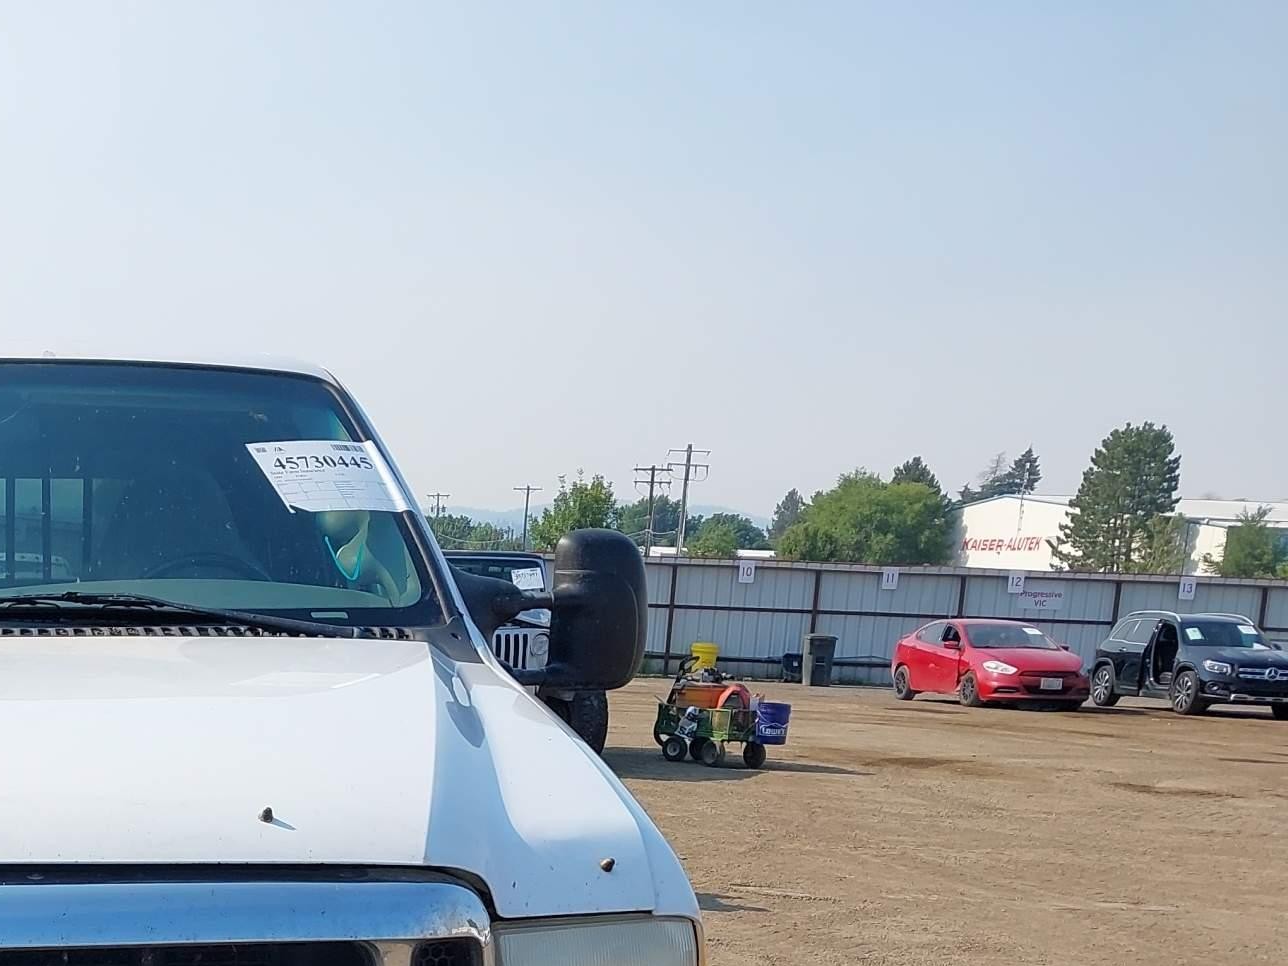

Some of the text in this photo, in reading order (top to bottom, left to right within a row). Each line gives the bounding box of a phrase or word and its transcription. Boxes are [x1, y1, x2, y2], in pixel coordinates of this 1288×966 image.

[274, 455, 374, 470] 45730445
[961, 536, 1042, 551] KAISER-ALUTEK
[742, 566, 753, 577] 10
[886, 572, 895, 583] 11
[1011, 576, 1022, 587] 12
[1182, 583, 1193, 593] 13
[1033, 599, 1047, 607] VIC
